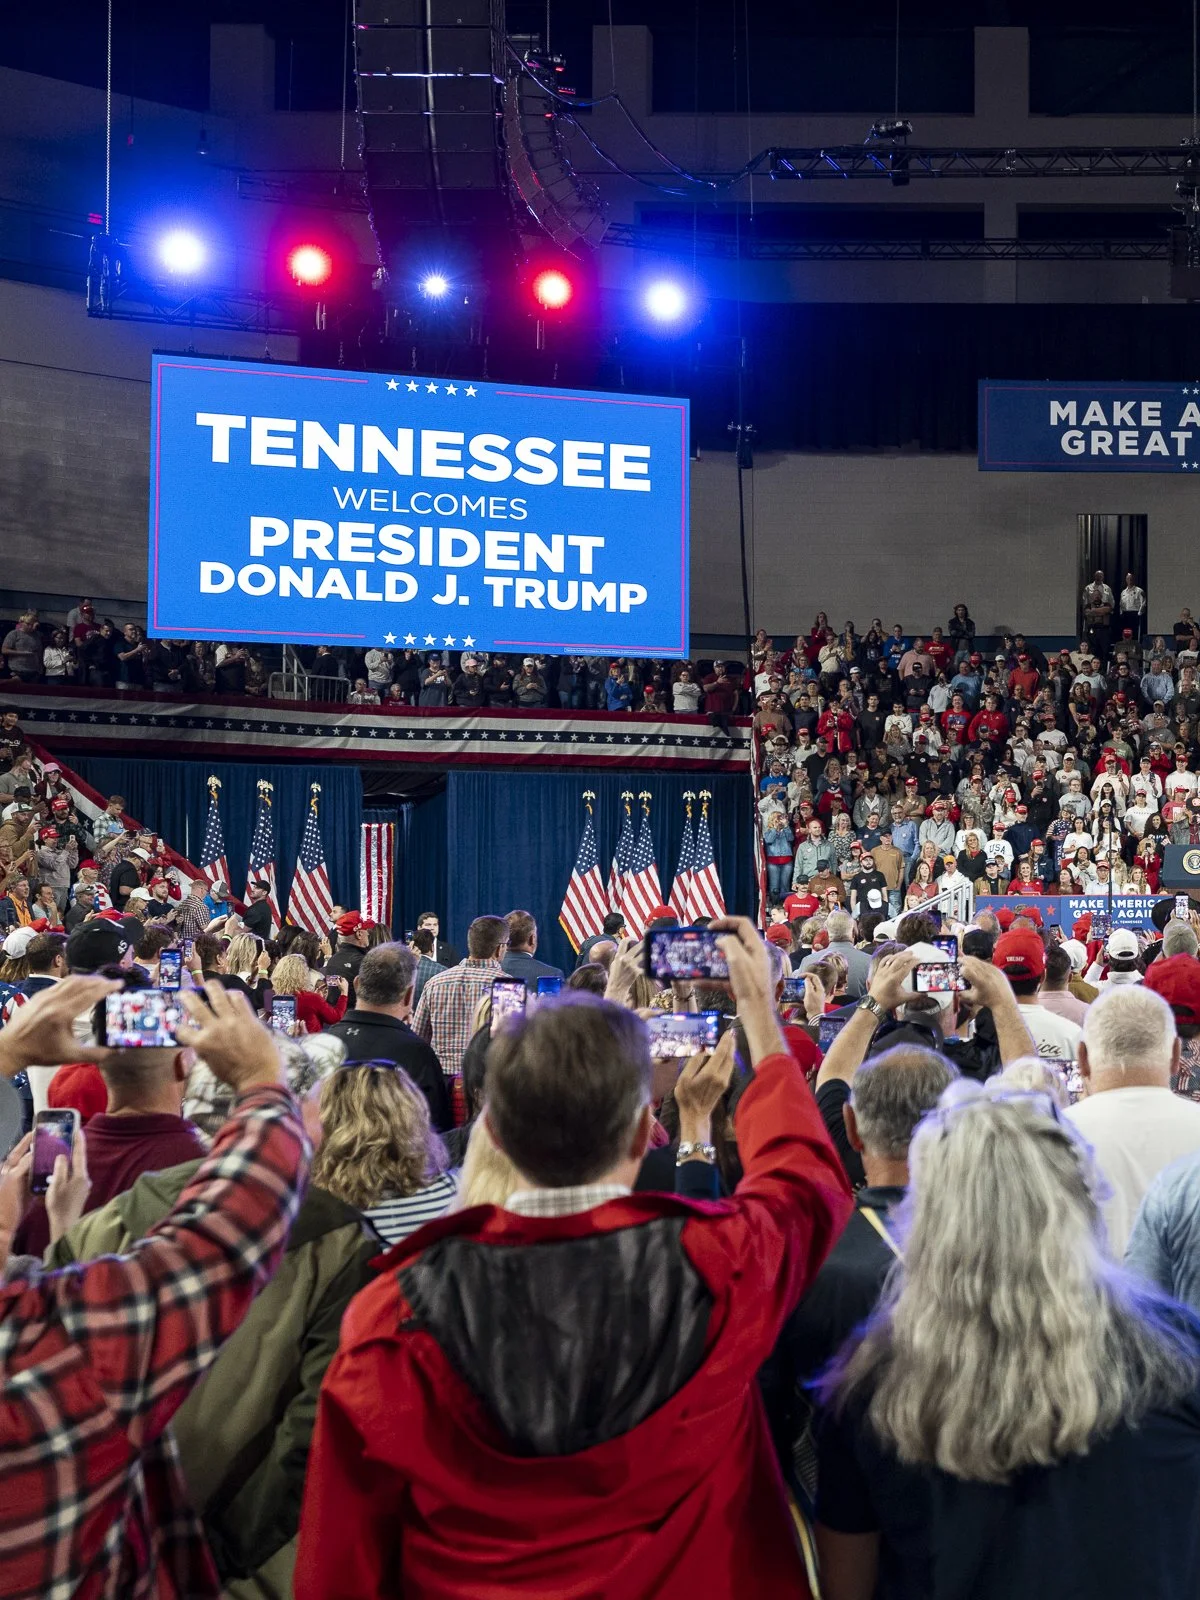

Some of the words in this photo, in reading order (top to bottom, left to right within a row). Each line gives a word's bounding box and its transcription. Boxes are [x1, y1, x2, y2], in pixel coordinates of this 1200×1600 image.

[1050, 401, 1161, 426] MAKE
[196, 413, 650, 491] TENNESSEE
[1061, 430, 1192, 455] GREAT
[333, 487, 527, 520] WELCOMES
[250, 517, 604, 574] PRESIDENT
[200, 562, 418, 602] DONALD
[432, 575, 469, 605] J.
[484, 577, 647, 612] TRUMP
[989, 844, 1006, 855] USA
[1069, 900, 1104, 908] MAKE
